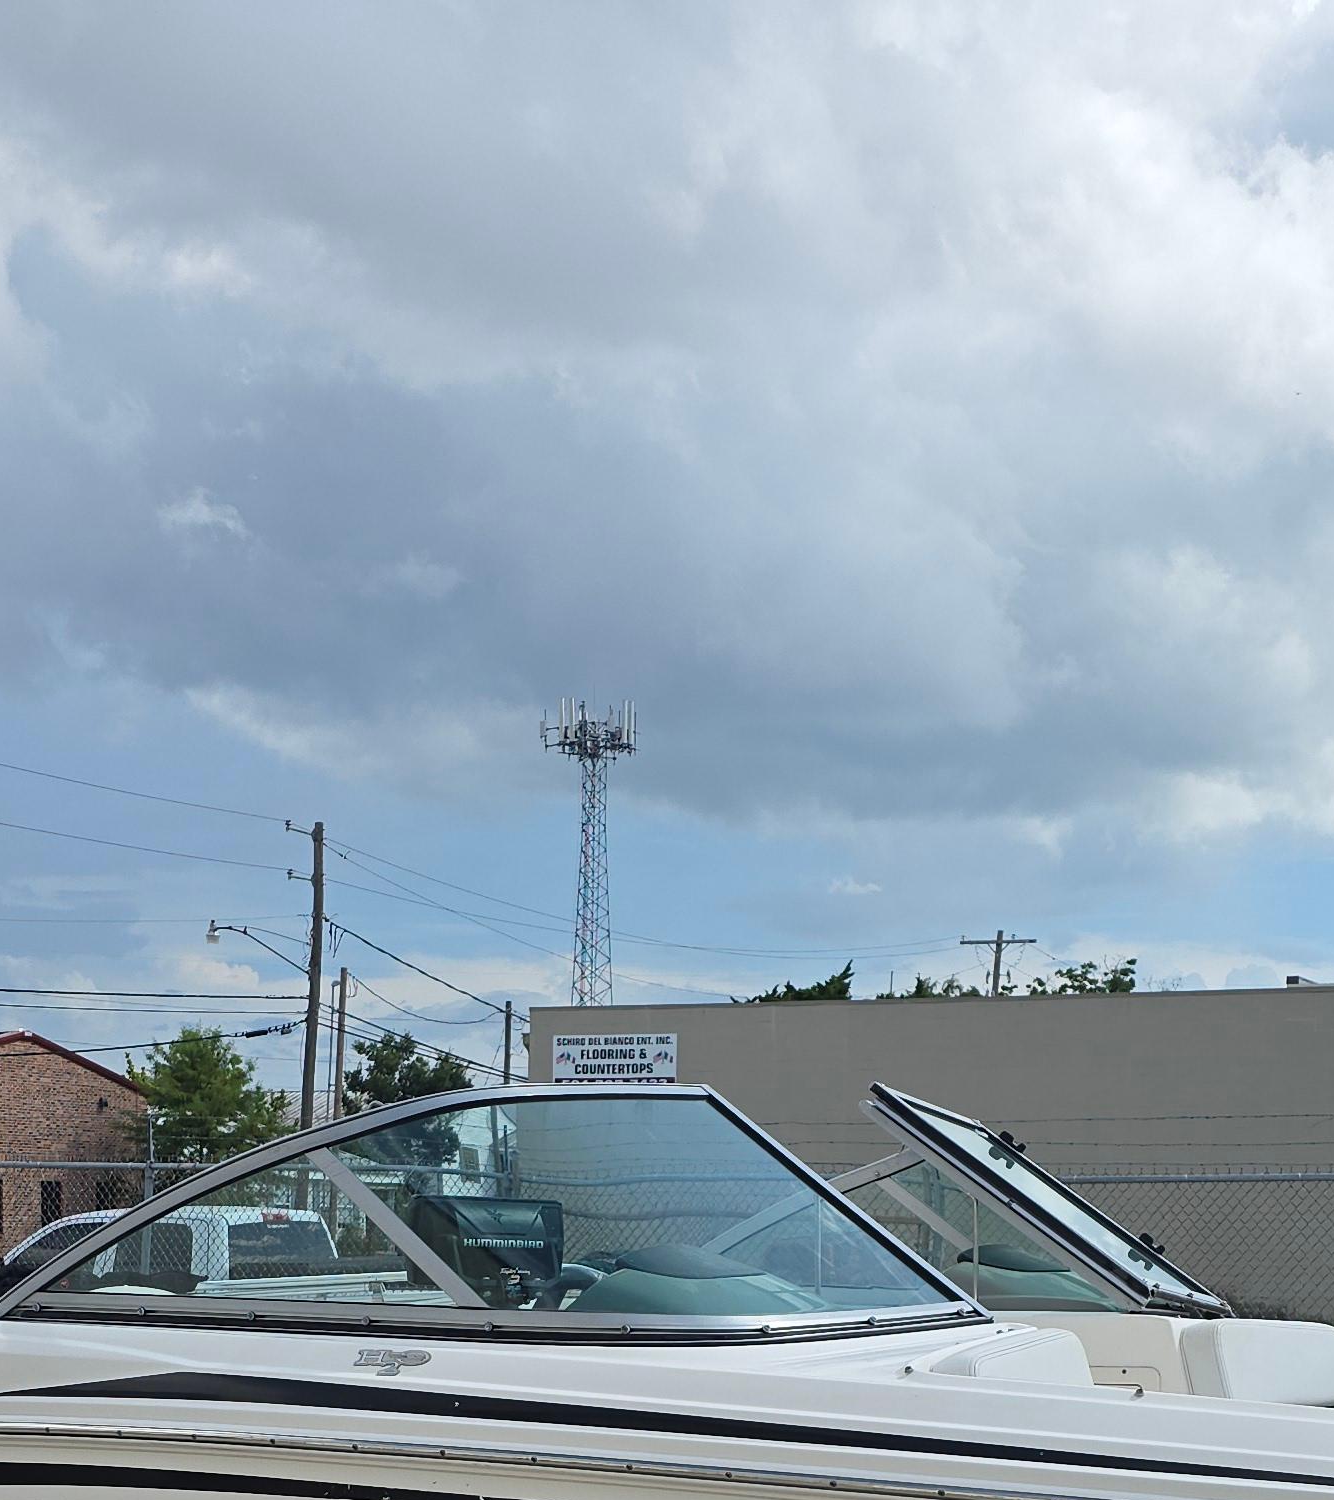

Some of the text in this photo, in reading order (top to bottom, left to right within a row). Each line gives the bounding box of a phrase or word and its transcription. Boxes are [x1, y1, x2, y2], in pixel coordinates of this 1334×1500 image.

[556, 1035, 673, 1047] SCHIRO DEL BIANCO ENT. INC.
[580, 1048, 648, 1060] FLOORING &
[574, 1062, 654, 1075] COUNTERTOPS
[463, 1238, 544, 1249] HUMMINBIRD
